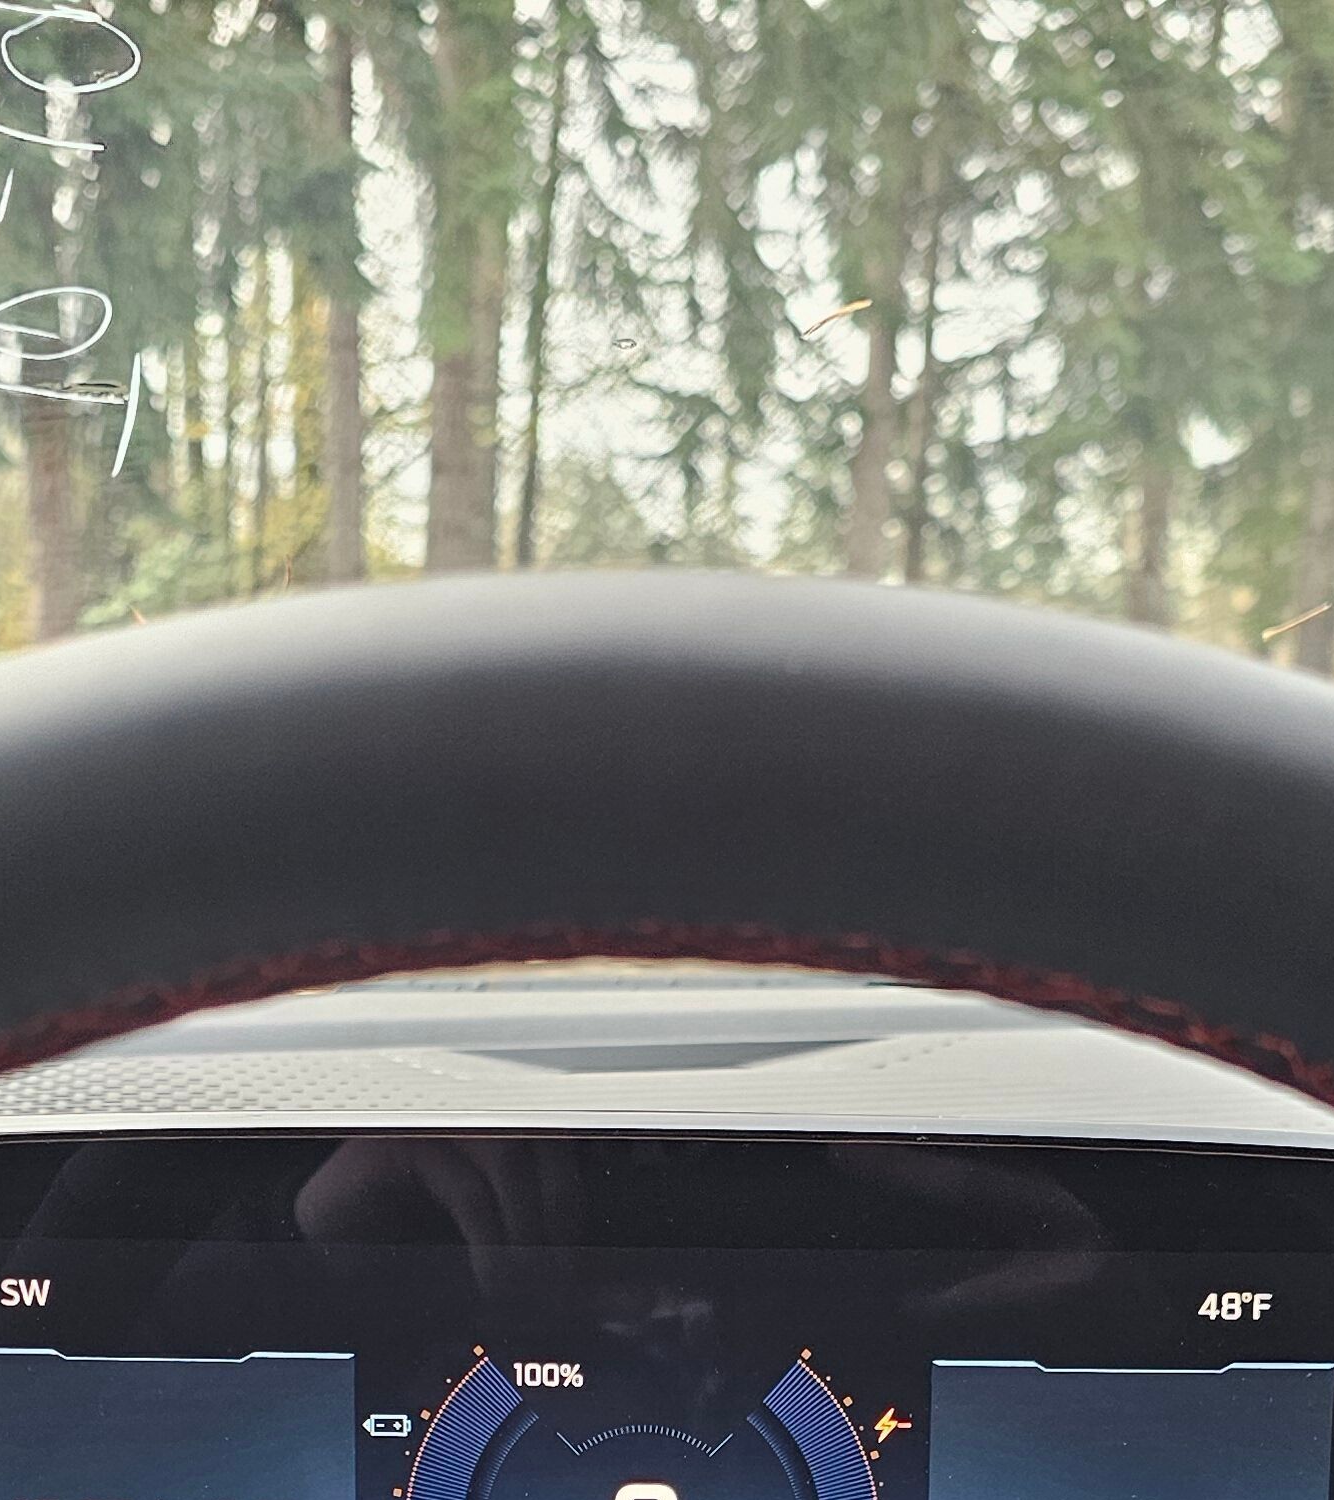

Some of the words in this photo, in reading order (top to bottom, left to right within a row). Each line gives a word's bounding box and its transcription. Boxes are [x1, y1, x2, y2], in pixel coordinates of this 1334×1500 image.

[0, 1278, 51, 1307] SW
[1197, 1292, 1273, 1321] 48°F
[513, 1362, 584, 1388] 100%
